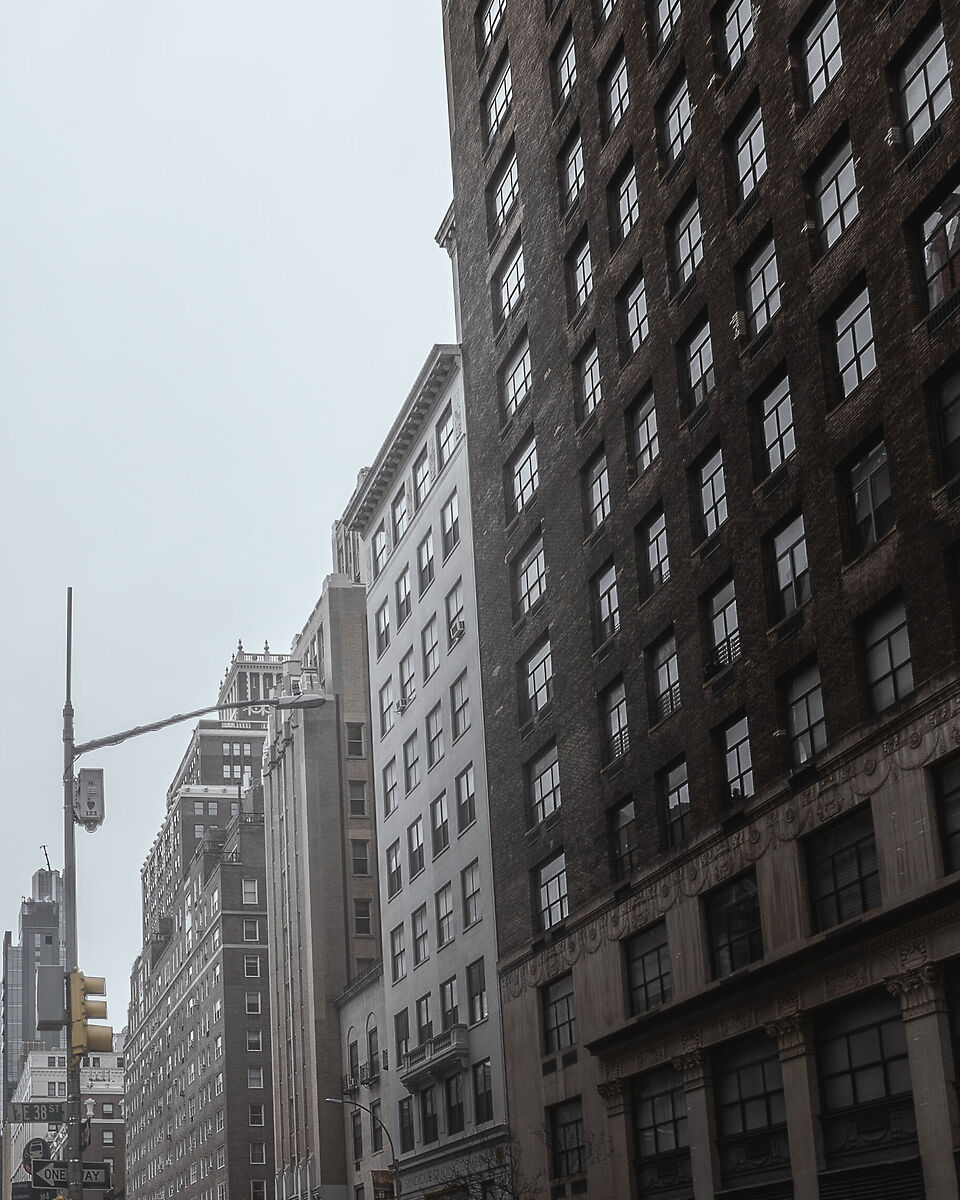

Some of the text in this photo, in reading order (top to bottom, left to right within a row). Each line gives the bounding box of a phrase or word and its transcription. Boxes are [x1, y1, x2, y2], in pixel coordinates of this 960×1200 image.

[23, 1104, 60, 1120] E 38 ST
[44, 1168, 100, 1181] ONE AY
